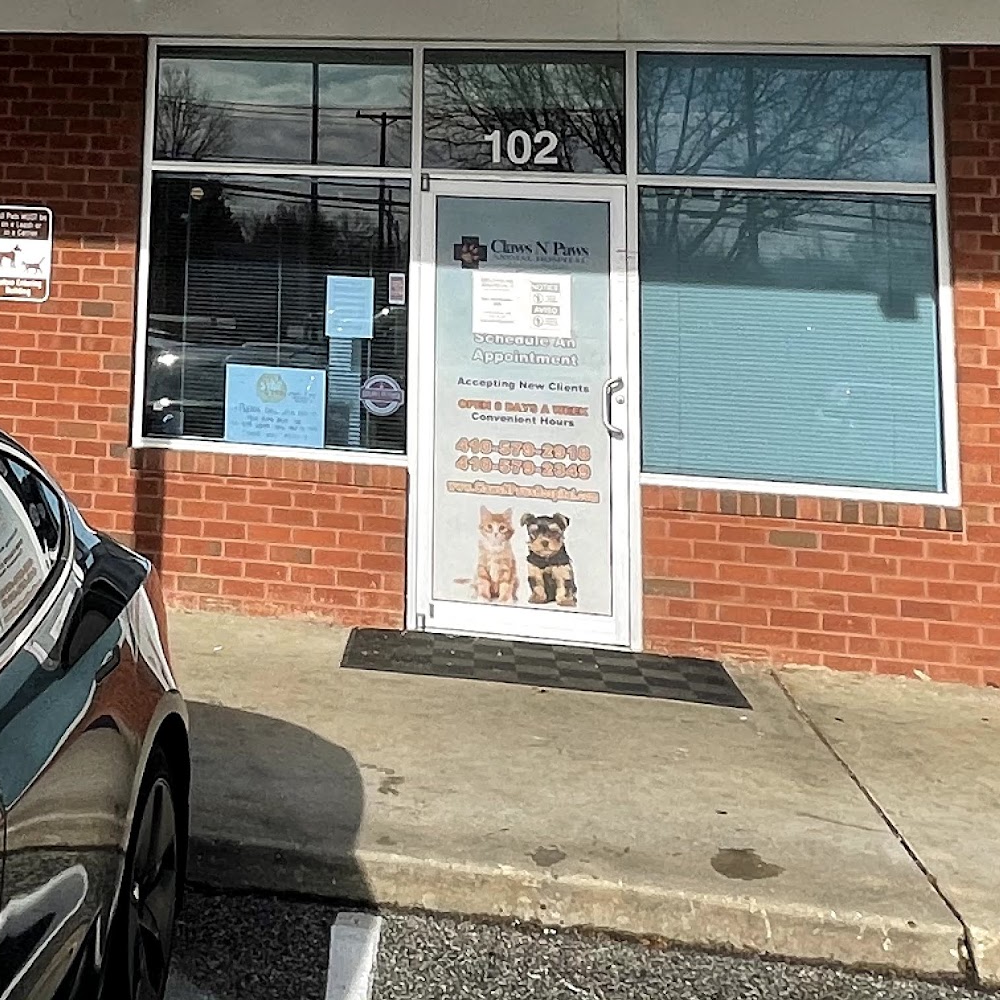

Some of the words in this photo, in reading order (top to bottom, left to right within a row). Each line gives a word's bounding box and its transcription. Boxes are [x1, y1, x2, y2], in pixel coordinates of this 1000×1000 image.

[484, 129, 559, 165] 102
[536, 241, 549, 255] N
[553, 241, 590, 257] Paws
[471, 348, 579, 367] Appointment
[457, 377, 516, 390] Accepting
[519, 380, 545, 390] New
[549, 382, 590, 393] Clients
[471, 412, 537, 425] Convenient
[540, 414, 575, 427] Hours
